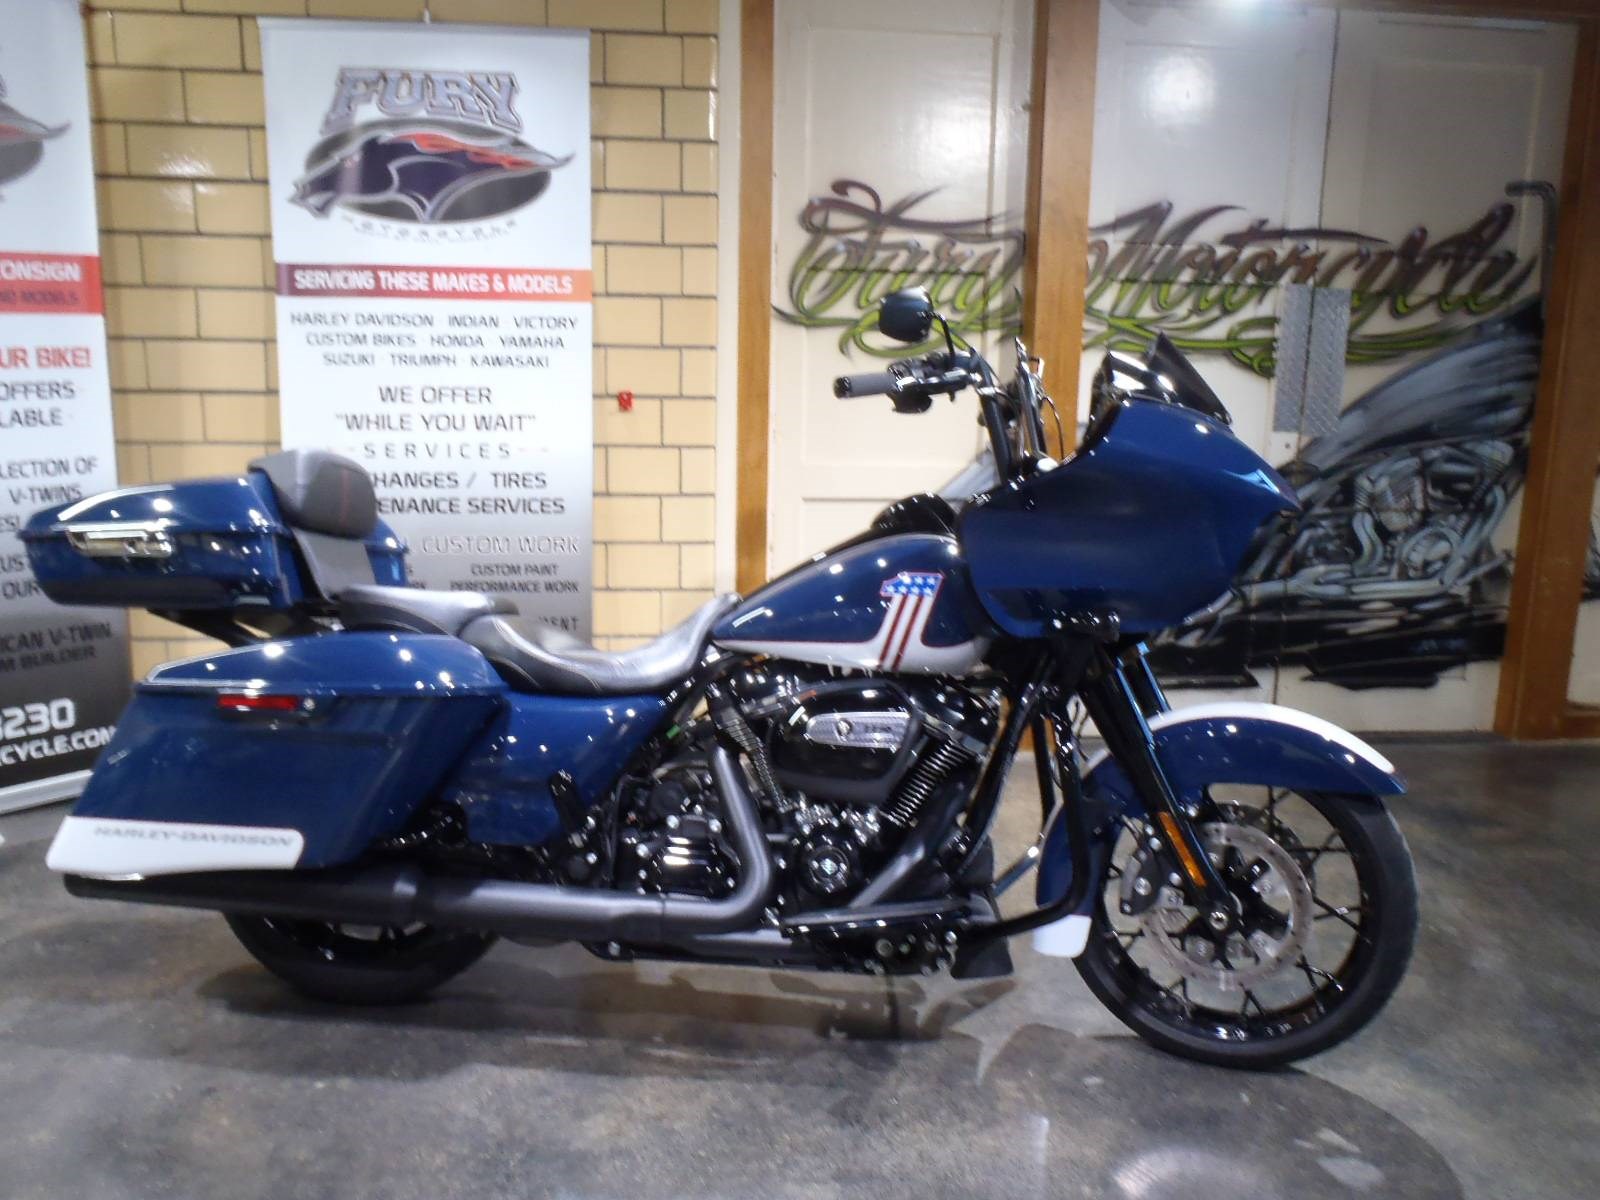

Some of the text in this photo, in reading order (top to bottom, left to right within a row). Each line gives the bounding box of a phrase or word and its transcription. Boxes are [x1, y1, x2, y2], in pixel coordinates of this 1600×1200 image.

[320, 66, 523, 136] FURY
[0, 259, 81, 282] ONSIGN
[294, 269, 573, 295] SERVICING THESE MAKES & MODELS
[290, 312, 579, 329] HARLEY DAVIDSON INDIAN VICTORY
[306, 332, 565, 349] CUSTOM BIKES HONDA YAMAHA
[36, 346, 92, 369] BIKE!
[322, 352, 551, 368] SUZUKI TRIUMPH KAWASAKI
[378, 386, 493, 404] WE OFFER
[335, 413, 536, 432] "WHILE YOU WAIT"
[363, 442, 511, 459] SERVICES
[75, 456, 98, 475] OF
[372, 471, 459, 489] HANGES
[490, 471, 547, 489] TIRES
[376, 496, 565, 515] ENANCE SERVICES
[422, 535, 511, 554] CUSTOM
[518, 535, 580, 554] WORK
[470, 562, 559, 576] CUSTOM PAINT
[450, 580, 579, 593] PERFORMANCE WORK
[0, 723, 118, 767] CYCLE.COM
